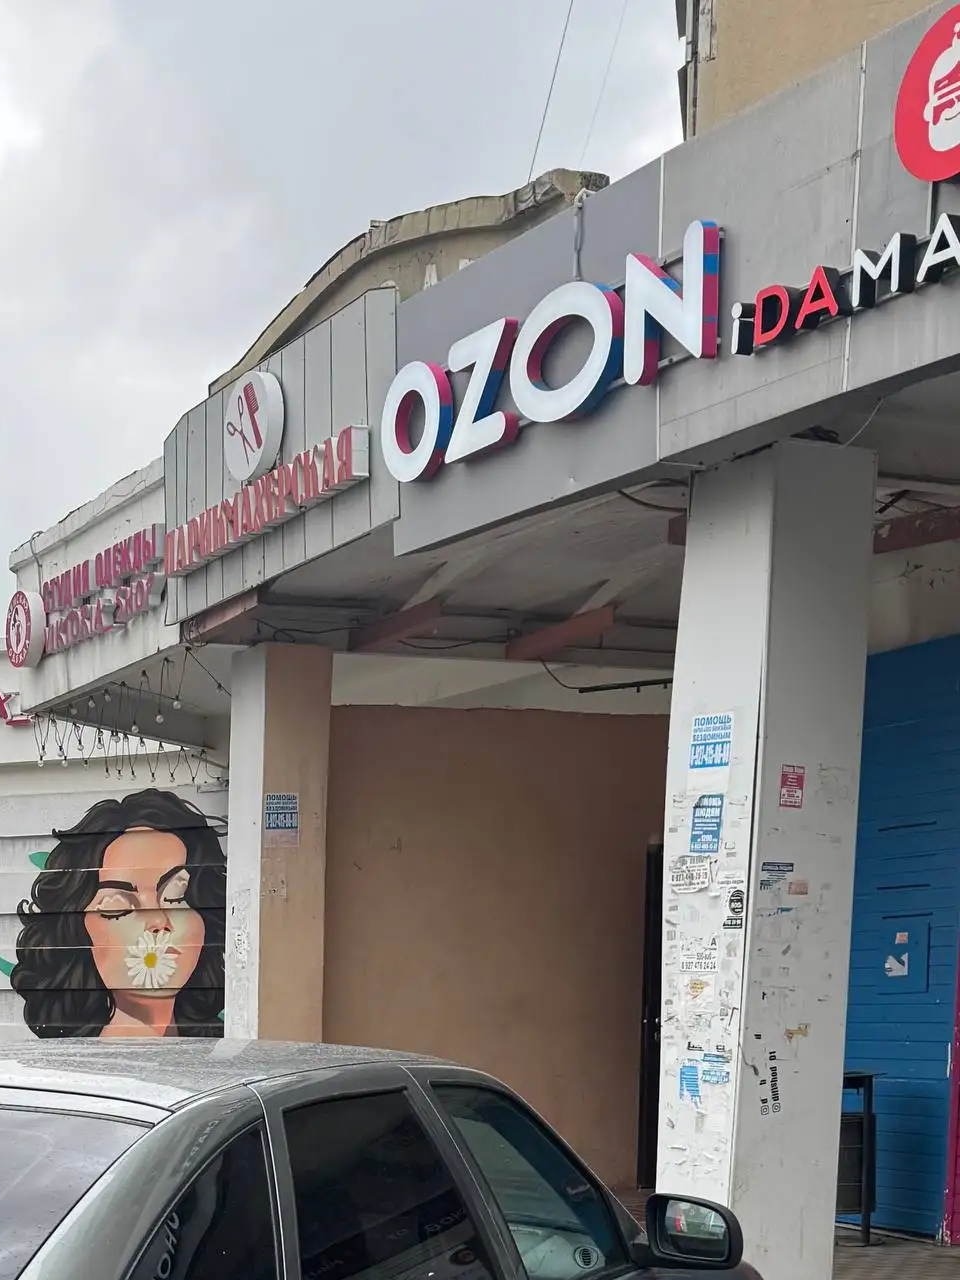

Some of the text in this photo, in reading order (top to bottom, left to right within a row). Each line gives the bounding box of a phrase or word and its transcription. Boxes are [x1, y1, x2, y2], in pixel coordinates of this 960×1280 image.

[381, 220, 719, 483] OZON
[163, 426, 353, 578] ПАРИКМАХЕРСКАЯ
[43, 523, 156, 614] СТУДИЯ ОДЕЖДЫ
[43, 598, 104, 654] VIKTORIA
